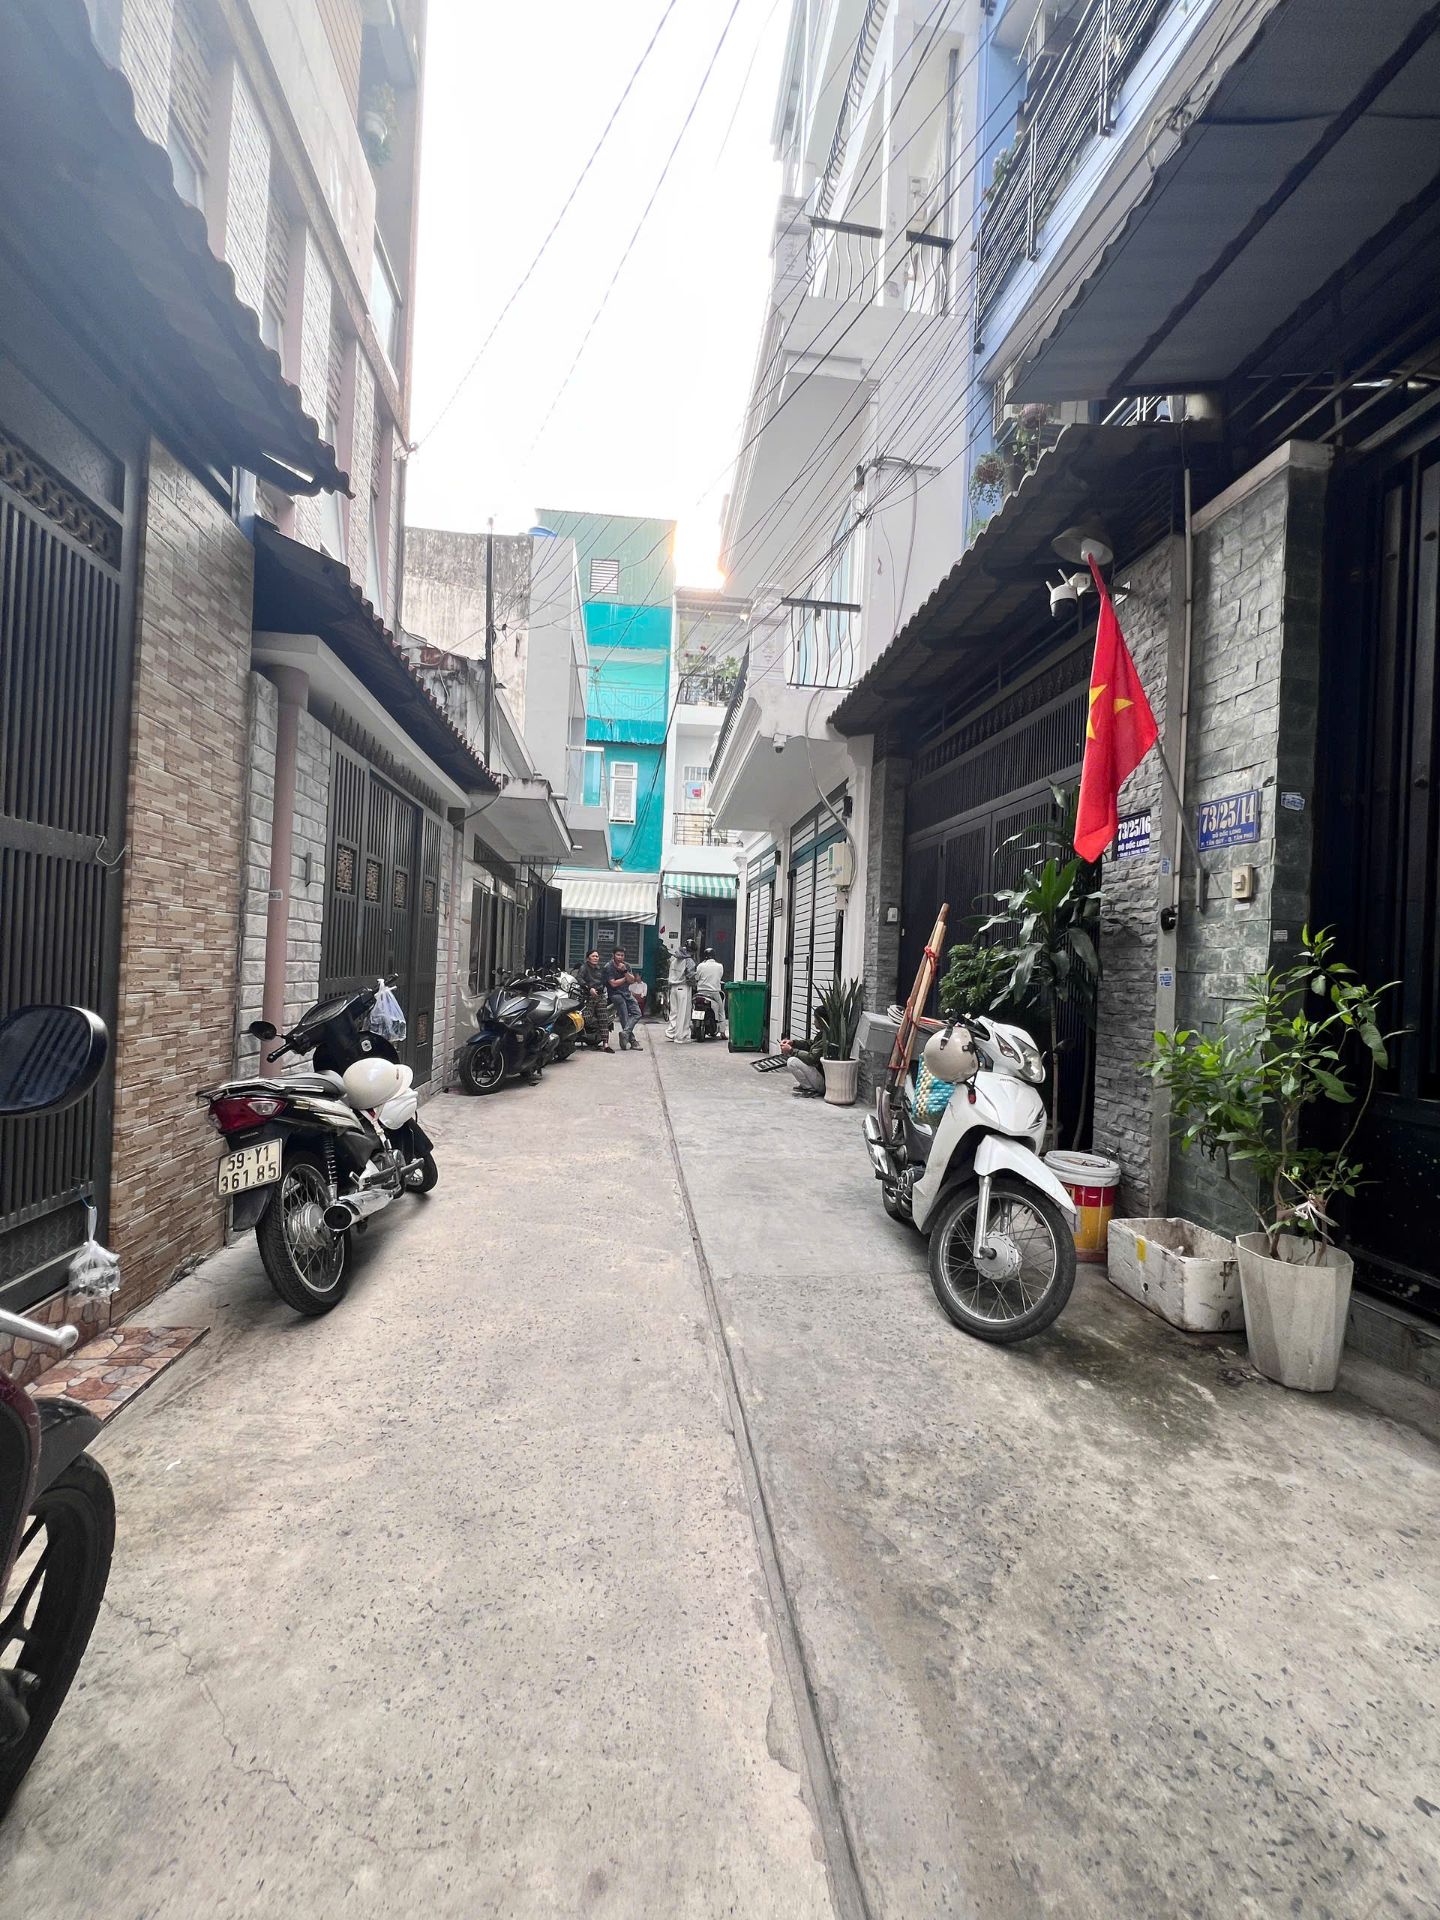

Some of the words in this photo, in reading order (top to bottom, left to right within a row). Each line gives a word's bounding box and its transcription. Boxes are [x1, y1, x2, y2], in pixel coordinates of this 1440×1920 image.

[1117, 816, 1151, 842] 73/25/16
[1202, 794, 1255, 834] 73/25/14
[226, 1145, 270, 1172] 59-Y1
[220, 1161, 278, 1194] 361.85
